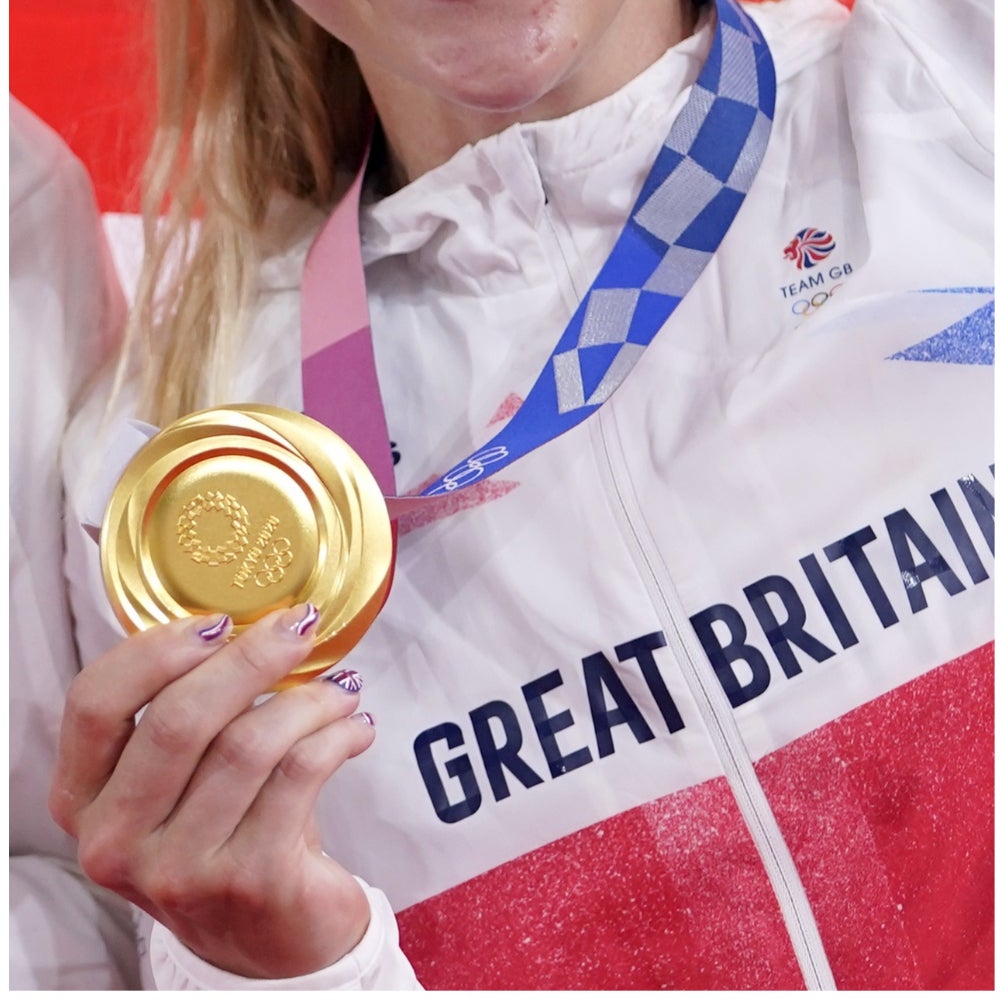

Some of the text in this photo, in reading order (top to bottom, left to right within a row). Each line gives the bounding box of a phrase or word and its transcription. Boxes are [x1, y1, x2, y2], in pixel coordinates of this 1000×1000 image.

[780, 263, 853, 298] TEAM GB
[413, 630, 685, 824] GREAT
